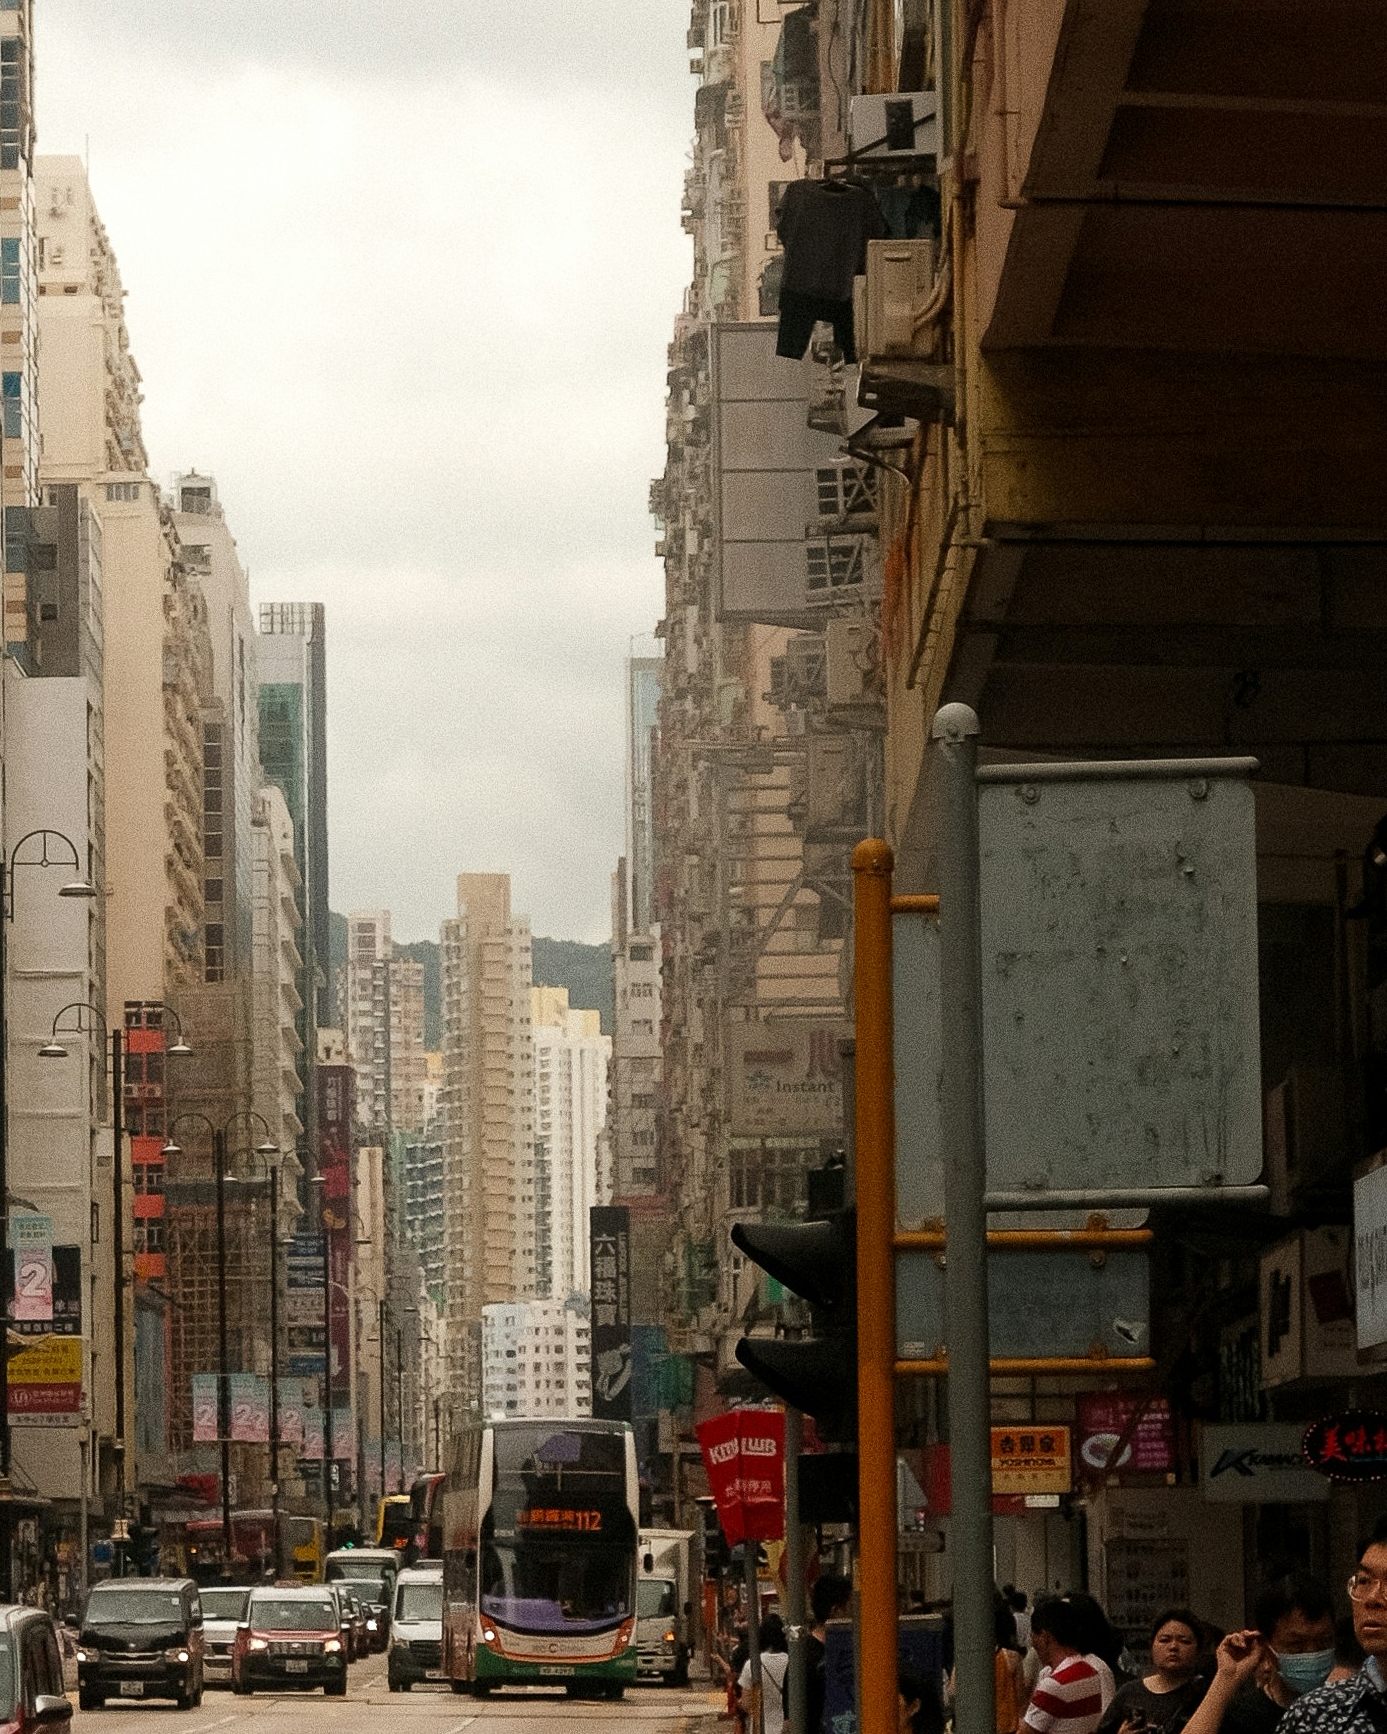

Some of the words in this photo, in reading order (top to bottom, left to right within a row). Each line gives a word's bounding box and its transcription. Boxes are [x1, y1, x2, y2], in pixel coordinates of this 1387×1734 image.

[776, 1080, 835, 1093] Instant
[20, 1262, 47, 1298] 2
[197, 1404, 215, 1427] 2
[235, 1404, 253, 1427] 2
[575, 1511, 603, 1531] 112
